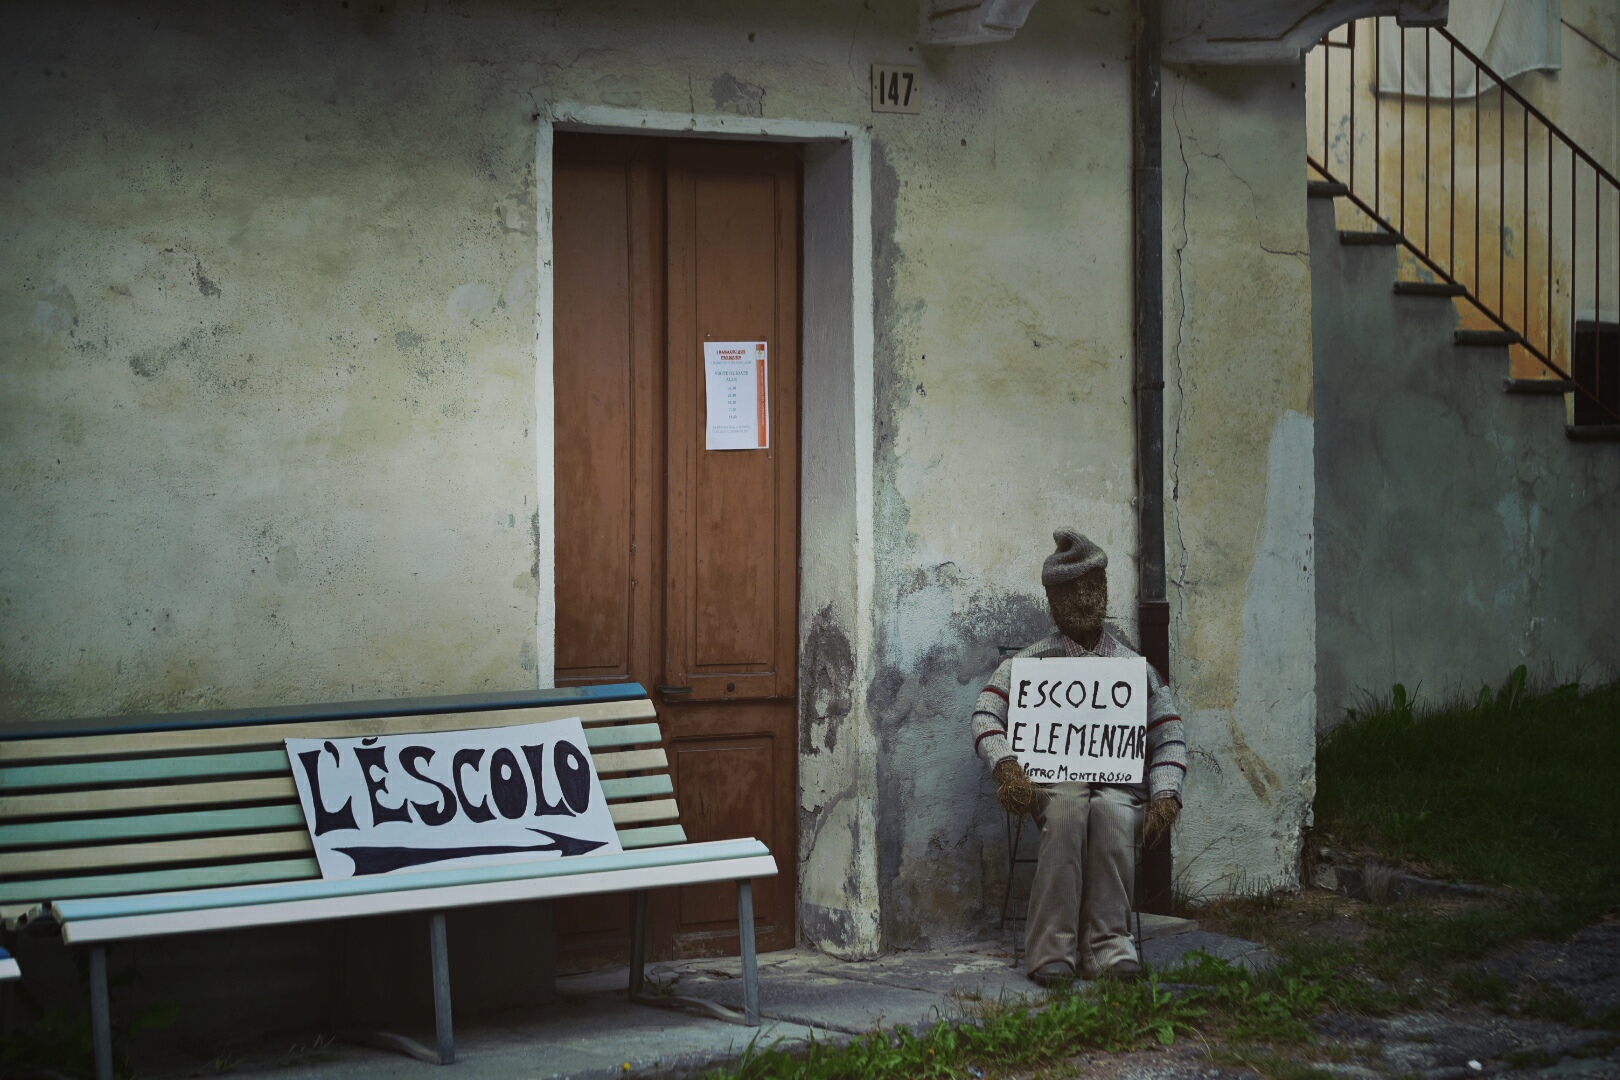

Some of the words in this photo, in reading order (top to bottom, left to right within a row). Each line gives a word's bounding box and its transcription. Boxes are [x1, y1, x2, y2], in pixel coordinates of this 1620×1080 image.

[880, 71, 913, 106] 147
[1017, 679, 1132, 709] ESCOLO
[1011, 721, 1146, 760] ELEMENTAR
